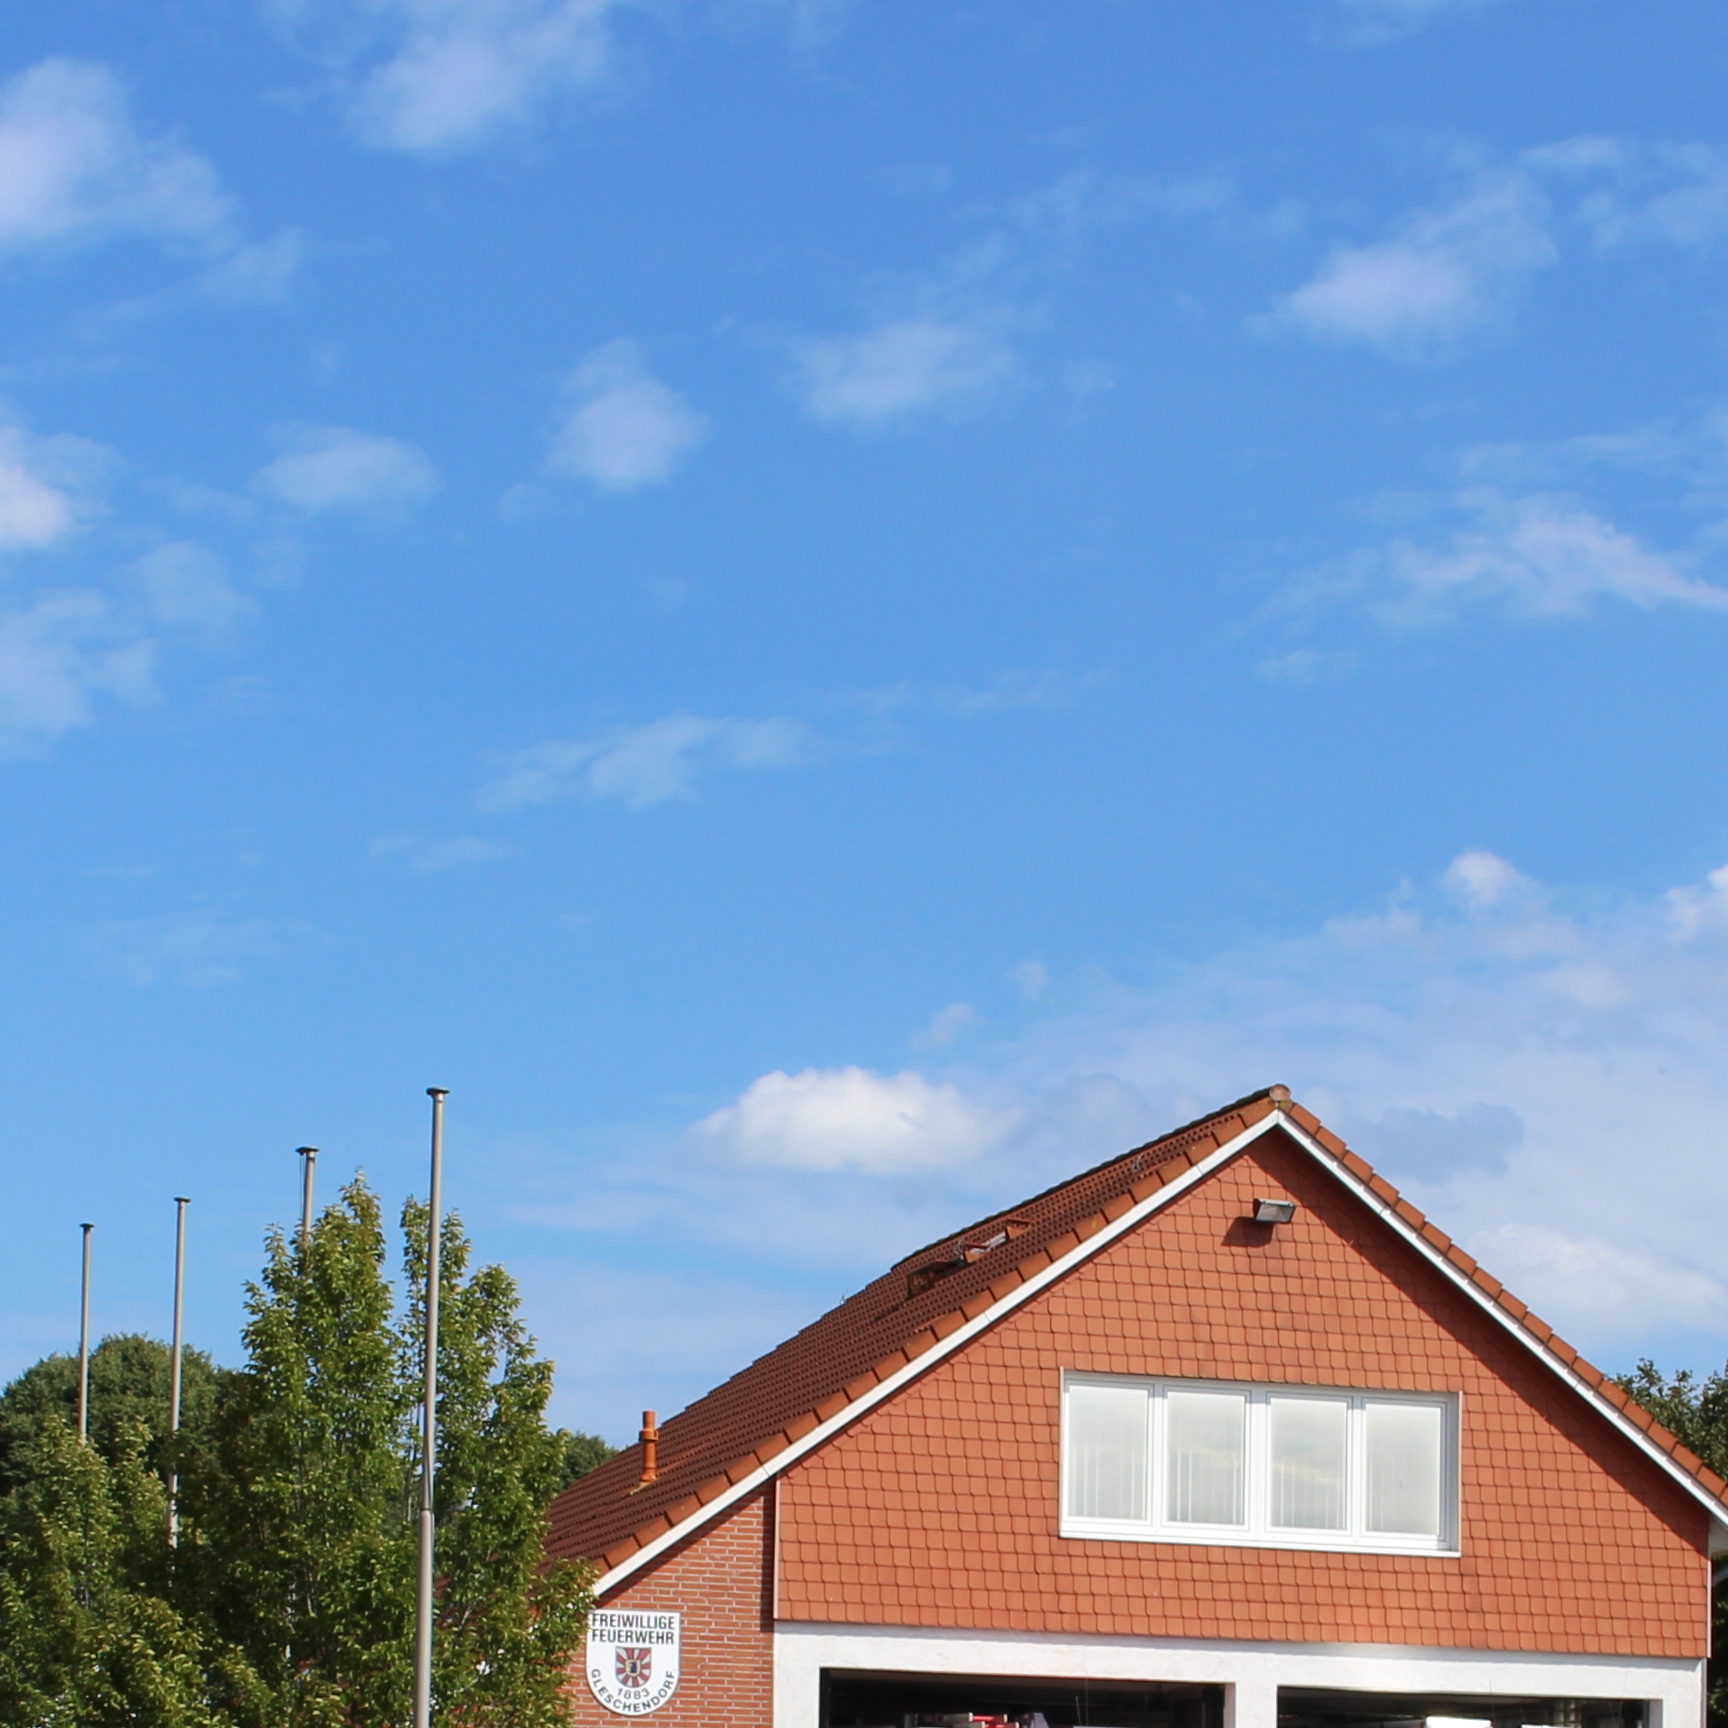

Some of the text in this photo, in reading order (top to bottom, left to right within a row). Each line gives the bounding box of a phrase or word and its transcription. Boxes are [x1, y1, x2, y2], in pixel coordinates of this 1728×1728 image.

[592, 1613, 675, 1630] FREIWILLIGE
[592, 1629, 674, 1645] FEUERWEHR
[591, 1668, 676, 1713] GLESCHENDORF
[617, 1688, 650, 1700] 1883
